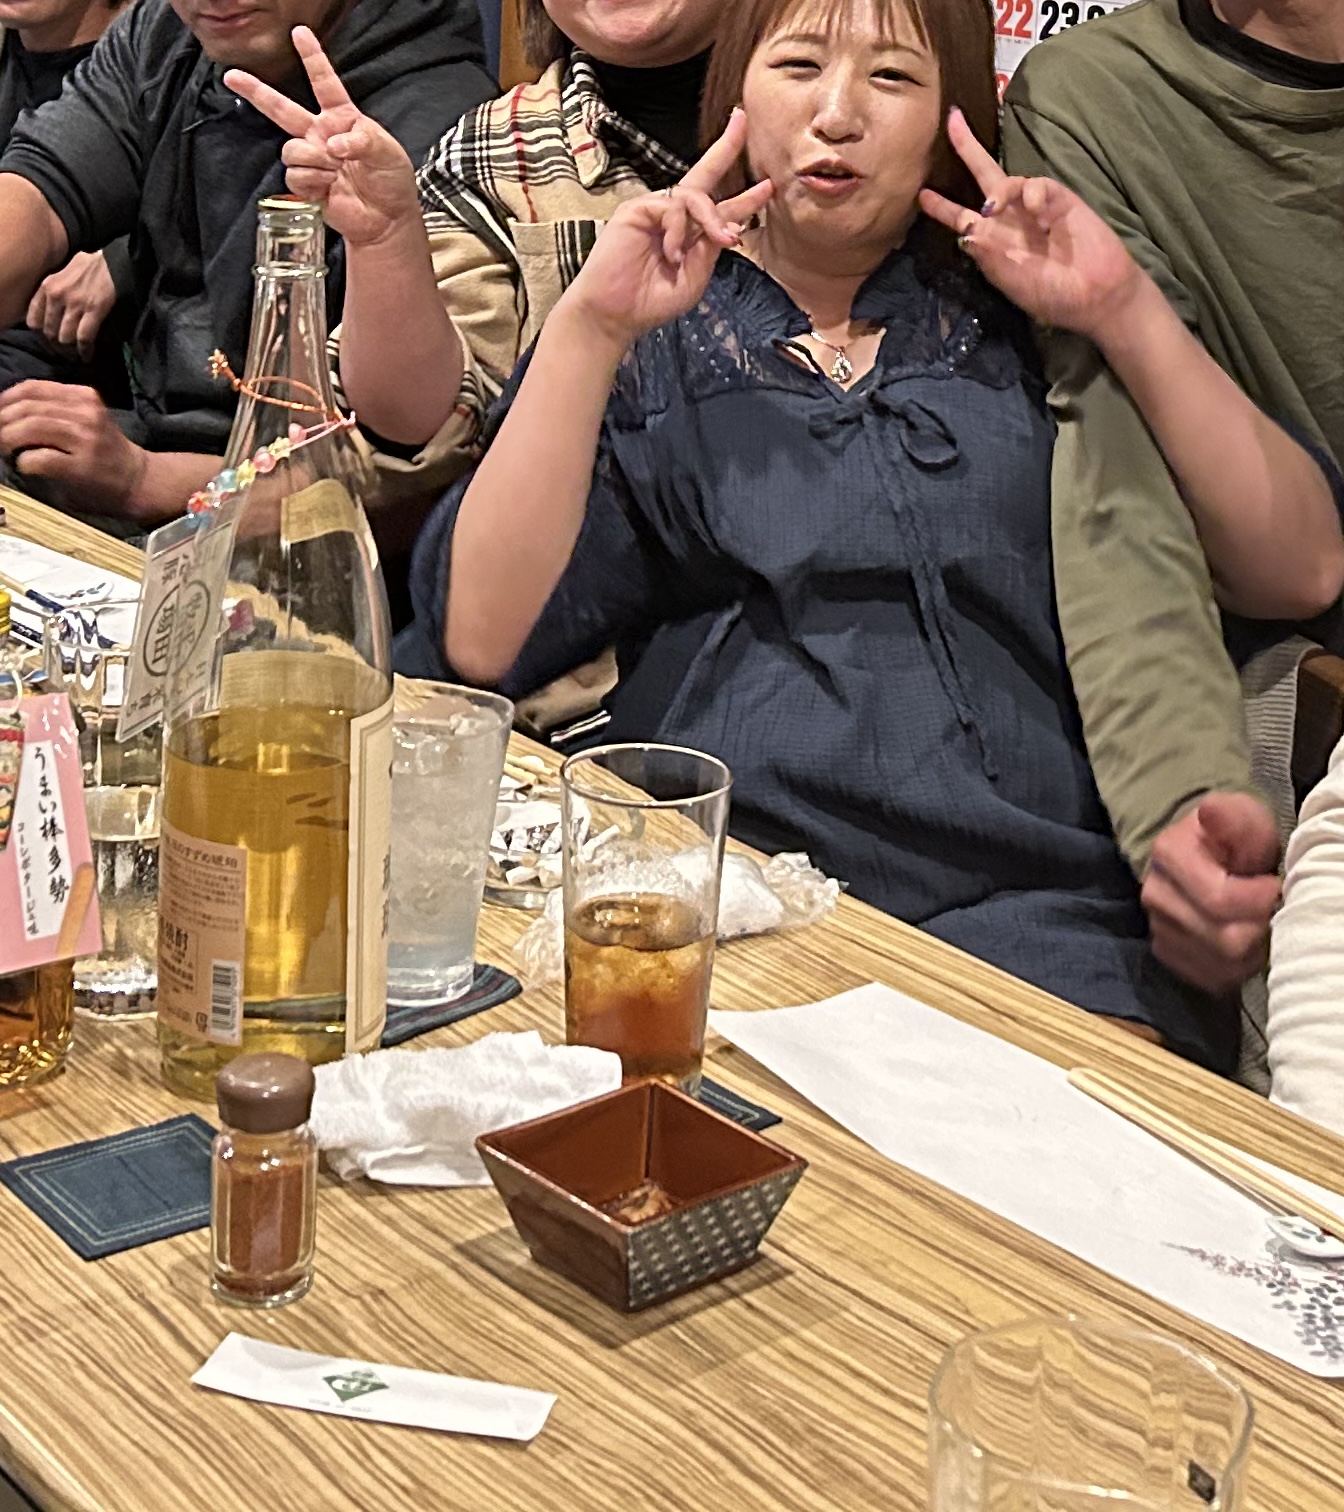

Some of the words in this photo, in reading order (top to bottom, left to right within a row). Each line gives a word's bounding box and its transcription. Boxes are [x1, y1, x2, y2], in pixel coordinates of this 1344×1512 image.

[34, 746, 70, 905] うまい棒多勢
